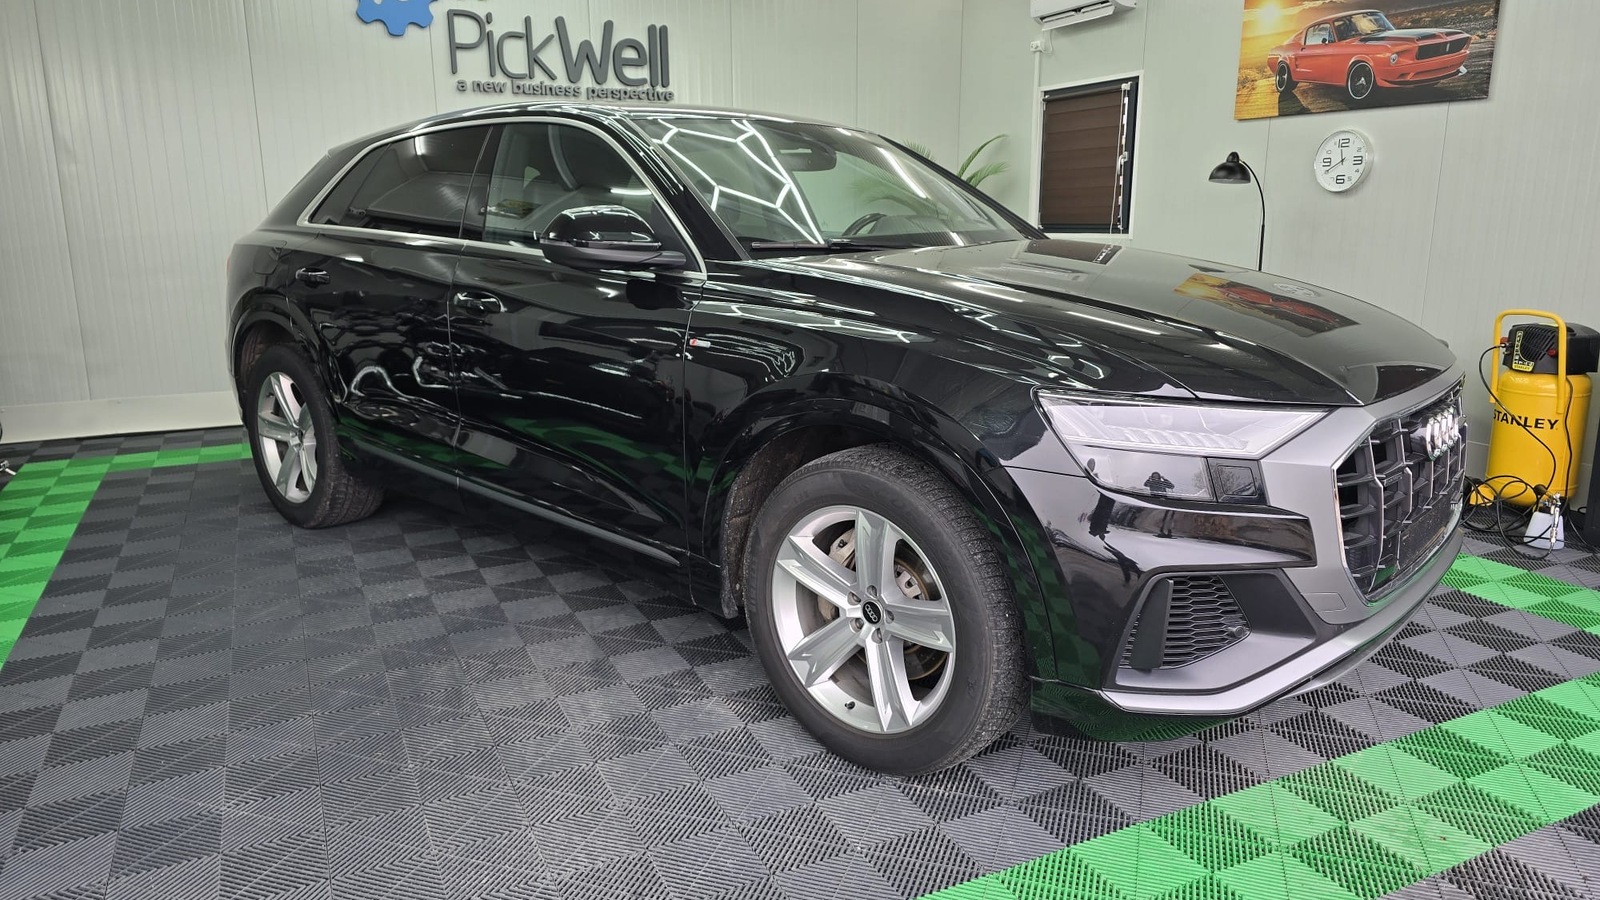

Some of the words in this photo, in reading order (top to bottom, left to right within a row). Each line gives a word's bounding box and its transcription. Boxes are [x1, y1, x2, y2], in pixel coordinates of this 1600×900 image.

[447, 9, 670, 88] PickWell
[456, 79, 468, 92] a
[472, 80, 507, 93] new
[511, 80, 582, 98] business
[586, 86, 675, 101] perspective
[1338, 138, 1350, 148] 12
[1322, 157, 1331, 167] 9
[1353, 155, 1363, 165] 3
[1336, 174, 1345, 184] 6
